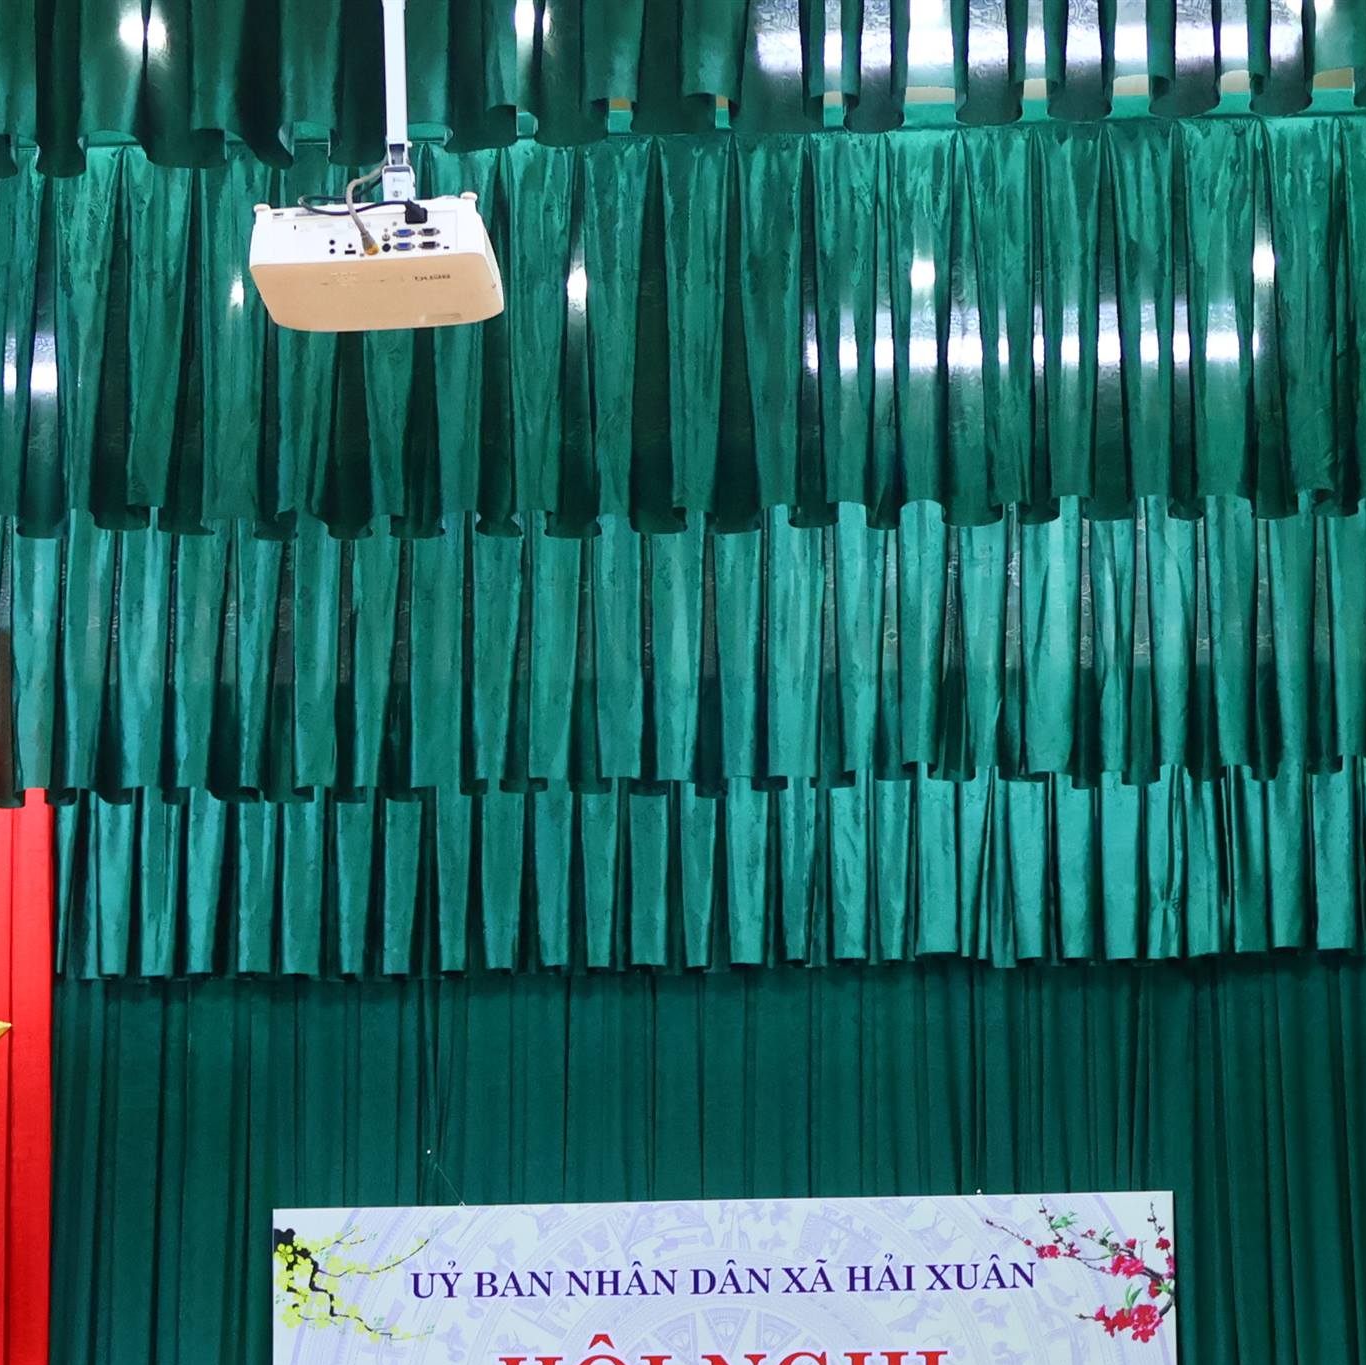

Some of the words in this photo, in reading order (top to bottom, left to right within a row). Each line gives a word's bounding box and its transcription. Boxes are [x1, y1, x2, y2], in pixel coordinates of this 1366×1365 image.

[409, 1259, 464, 1299] UỶ
[473, 1270, 554, 1298] BAN
[565, 1260, 679, 1297] NHÂN
[689, 1258, 772, 1295] DÂN
[781, 1258, 836, 1294] XÃ
[845, 1253, 916, 1293] HẢI
[925, 1253, 1037, 1292] XUÂN
